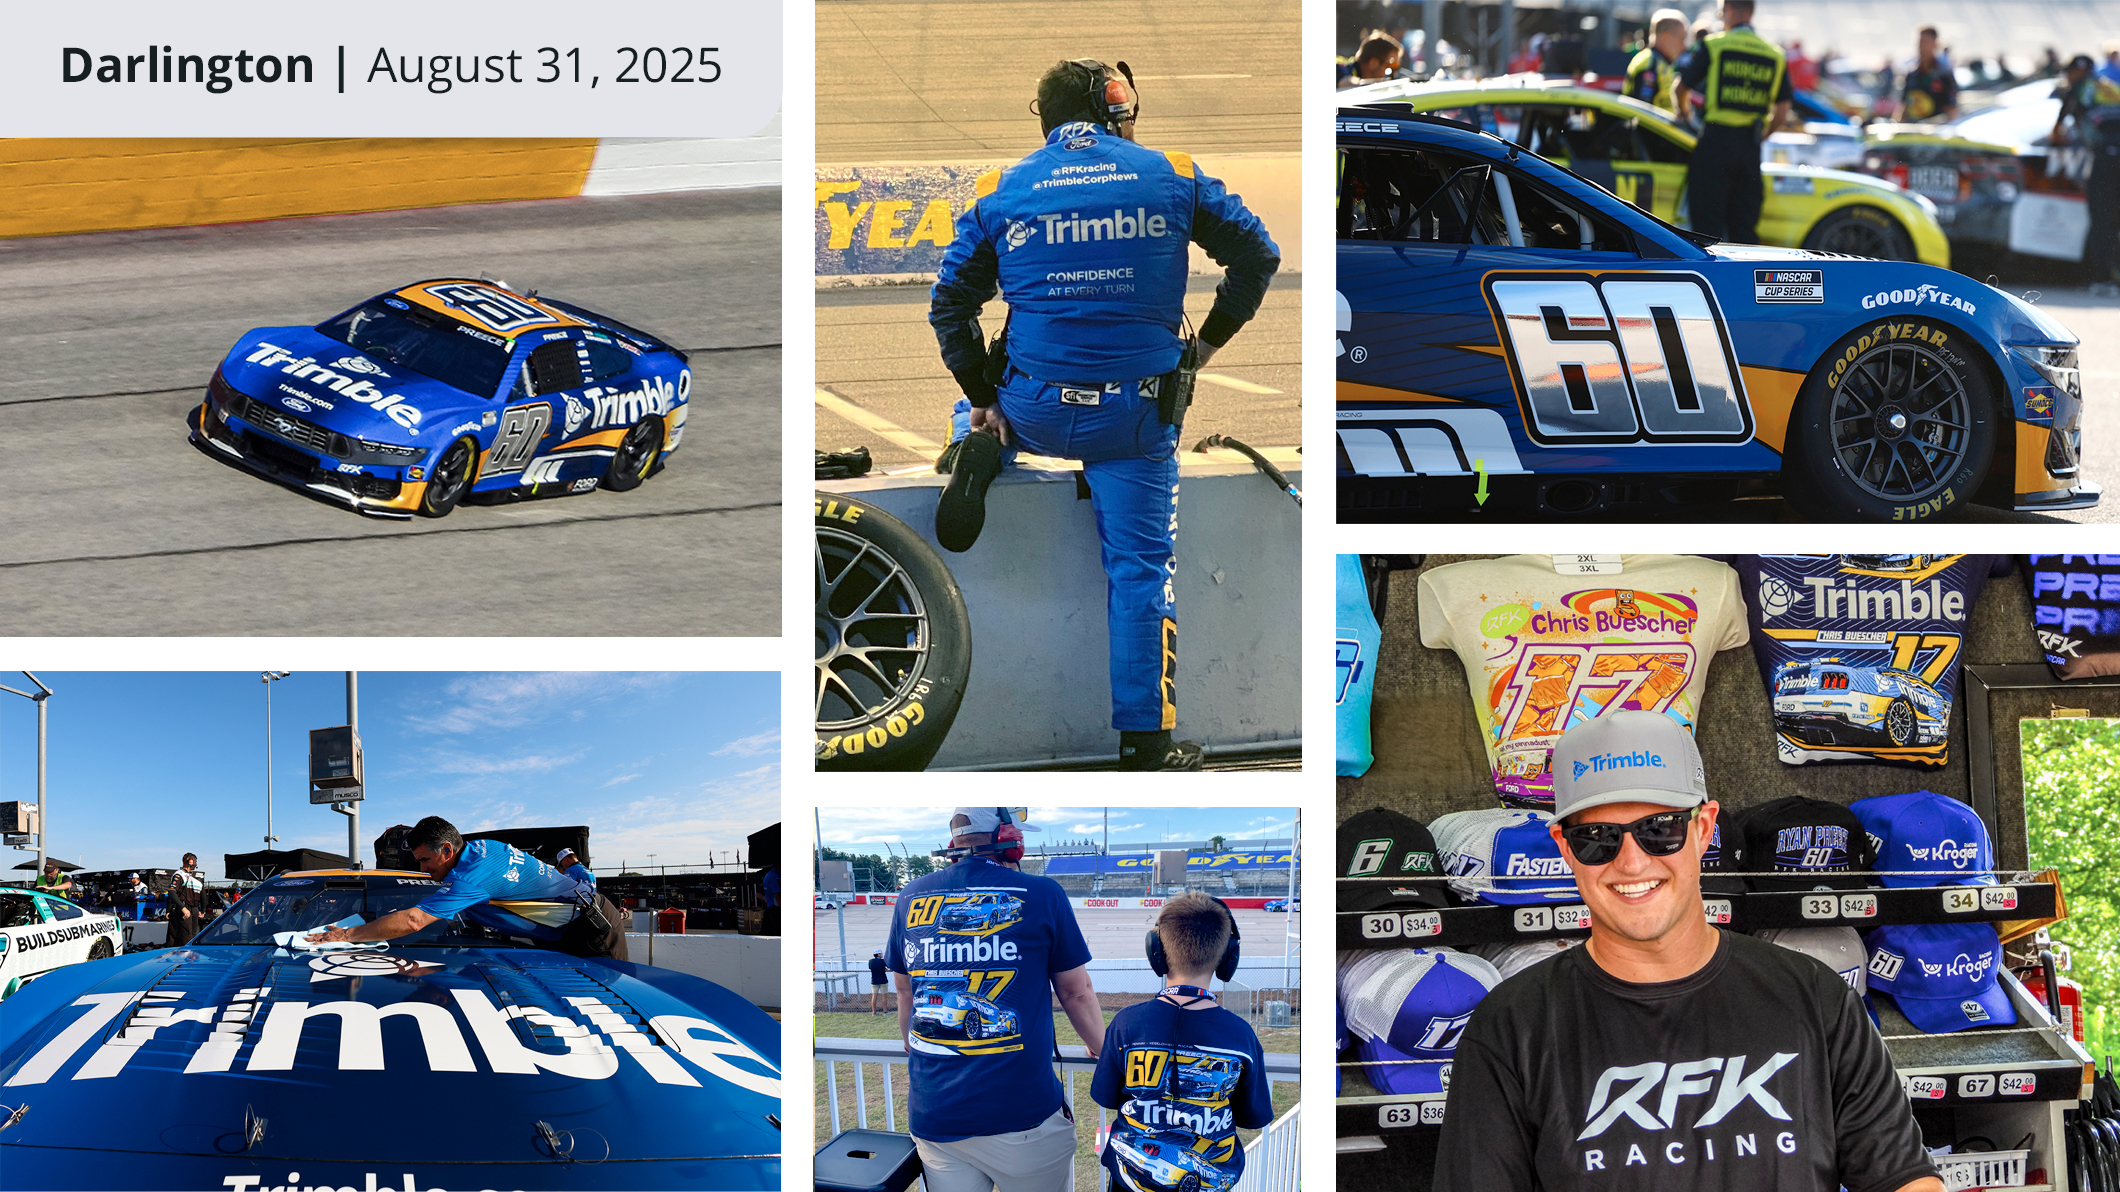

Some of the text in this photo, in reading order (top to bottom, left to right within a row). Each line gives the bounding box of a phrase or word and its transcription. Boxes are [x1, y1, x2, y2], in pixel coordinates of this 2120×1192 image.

[1722, 60, 1773, 81] MORGAN
[1058, 121, 1098, 142] RFK
[1069, 138, 1094, 149] Ford
[1051, 163, 1117, 177] @RFKracing
[1032, 173, 1139, 190] @TrimbleCorpNews
[825, 199, 976, 249] YEA
[1037, 207, 1167, 245] Trimble
[1047, 267, 1134, 283] CONFIDENCE
[1776, 272, 1813, 283] NASCAR
[1048, 283, 1135, 297] AT EVERY TURN
[1764, 286, 1814, 296] CUP SERIES
[457, 325, 505, 347] PREECE
[1487, 275, 1752, 441] 60
[246, 341, 422, 428] Trimble
[278, 384, 334, 411] Trimble.com
[585, 376, 676, 429] Trimble
[2026, 399, 2054, 408] SUNOCO
[480, 403, 552, 479] 60
[337, 464, 363, 475] RFK
[1893, 487, 1956, 520] EAGLE
[1803, 576, 1965, 622] Trimble
[1487, 609, 1522, 632] RFK
[1531, 610, 1697, 635] Chris Buescher
[1817, 631, 1887, 642] CHRIS BUESCHER
[2037, 630, 2083, 658] RFK
[1887, 632, 1962, 686] 17
[1496, 642, 1697, 741] 17
[1783, 674, 1819, 689] Trimble
[843, 701, 925, 755] GOOD
[1777, 740, 1797, 758] RFK
[1589, 751, 1662, 773] Trimble
[1506, 785, 1519, 793] FORD
[1776, 826, 1849, 854] RYAN PREECE
[1348, 840, 1388, 875] 6
[1404, 853, 1433, 871] RFK
[1801, 847, 1834, 868] 60
[1932, 839, 1978, 869] Kroger
[1455, 854, 1484, 877] 17
[1087, 899, 1119, 907] COOK OUT
[1809, 900, 1832, 914] 33
[1950, 893, 1973, 908] 34
[1985, 892, 2004, 904] $42
[906, 895, 945, 929] 60
[1522, 912, 1544, 926] 31
[1558, 911, 1579, 923] $32
[16, 919, 115, 953] BUILDSUBMARINES
[122, 926, 134, 941] 17
[1370, 919, 1394, 933] 30
[920, 935, 1018, 963] Trimble
[1868, 949, 1904, 980] 60
[1946, 953, 1993, 982] Kroger
[967, 970, 1016, 1001] 17
[3, 988, 781, 1098] Trimble
[1420, 1018, 1472, 1049] 17
[1126, 1050, 1169, 1088] 60
[1913, 1082, 1932, 1093] $42
[1966, 1080, 1989, 1093] 67
[2003, 1078, 2022, 1090] $42
[1576, 1052, 1800, 1141] RFK
[1137, 1100, 1232, 1135] Trimble
[1387, 1109, 1411, 1123] 63
[1423, 1107, 1444, 1119] $36
[1585, 1132, 1796, 1171] RACING
